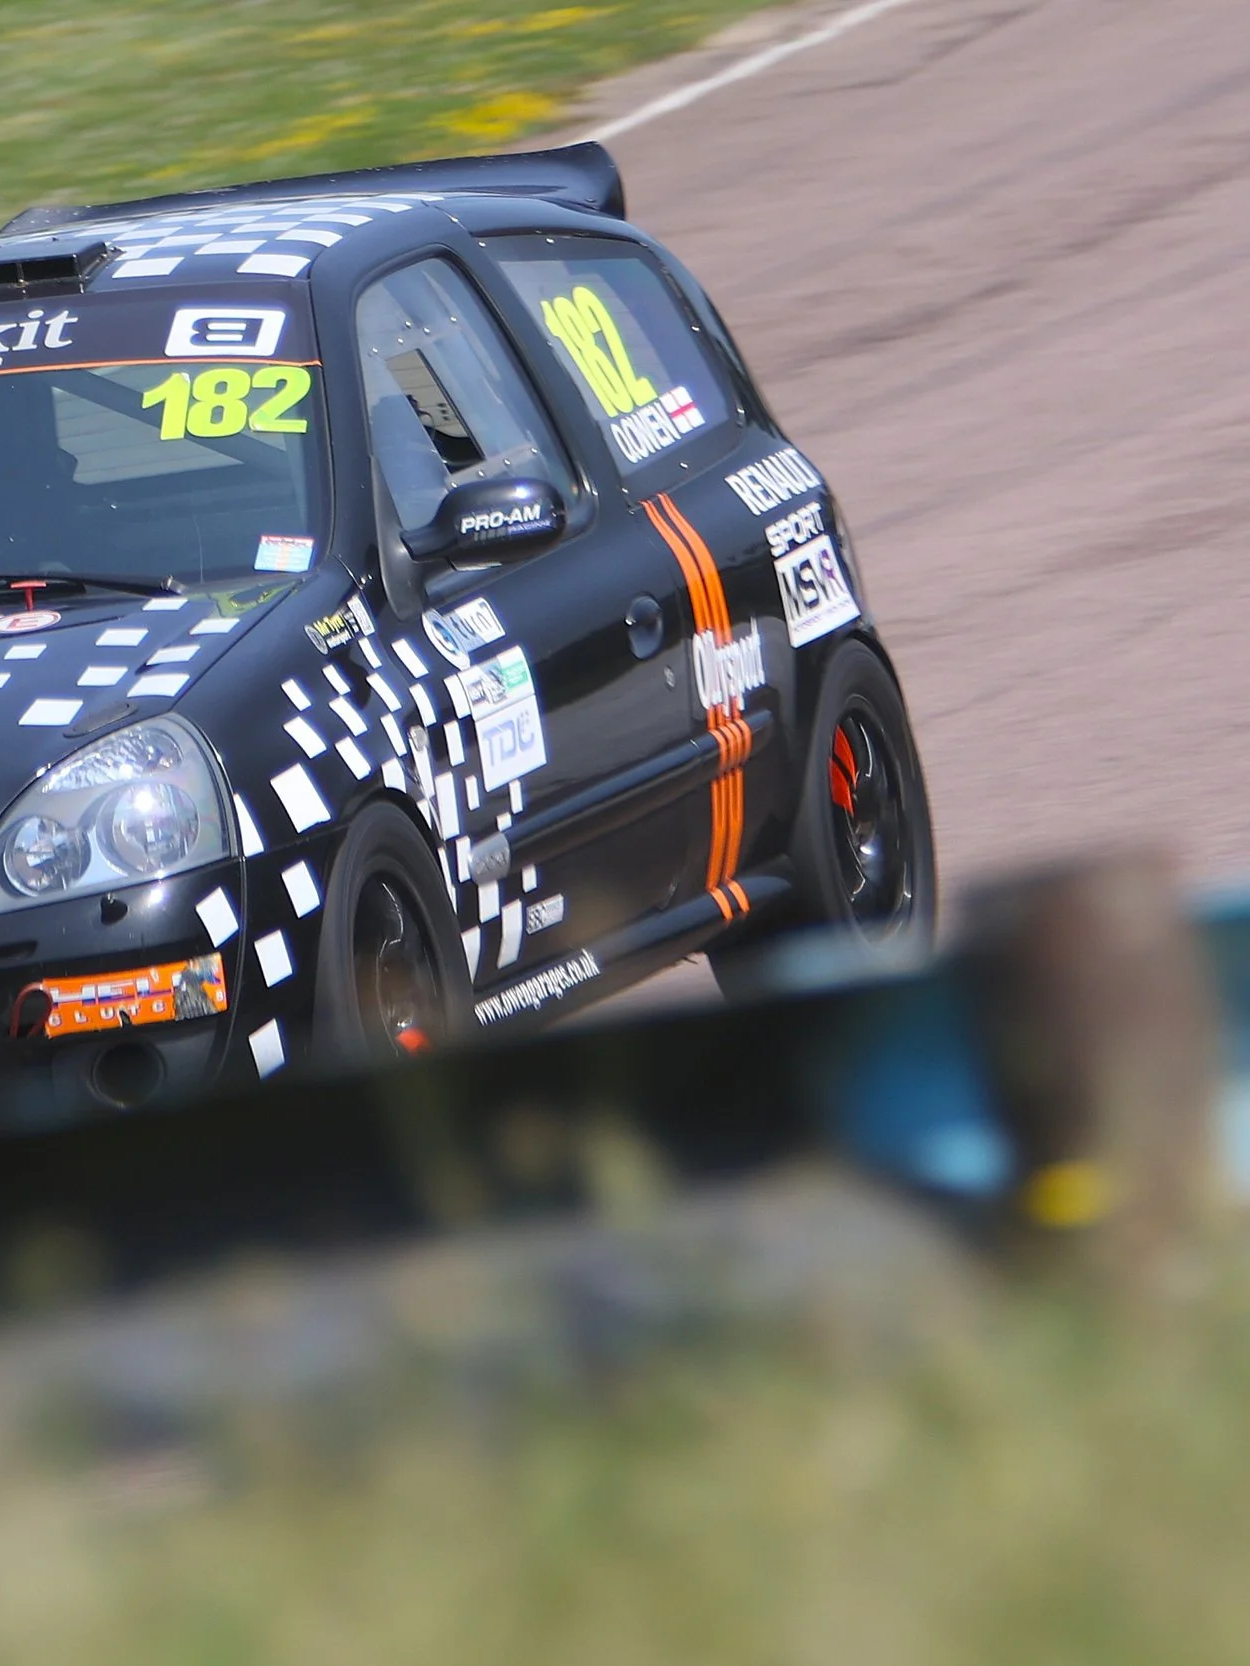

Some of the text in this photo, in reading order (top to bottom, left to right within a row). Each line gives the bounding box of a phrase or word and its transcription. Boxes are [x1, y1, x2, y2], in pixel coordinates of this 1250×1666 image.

[541, 286, 658, 417] 182
[142, 366, 311, 440] 182
[725, 448, 821, 516] RENAULT
[461, 503, 541, 534] PRO-AM
[765, 502, 825, 557] SPORT
